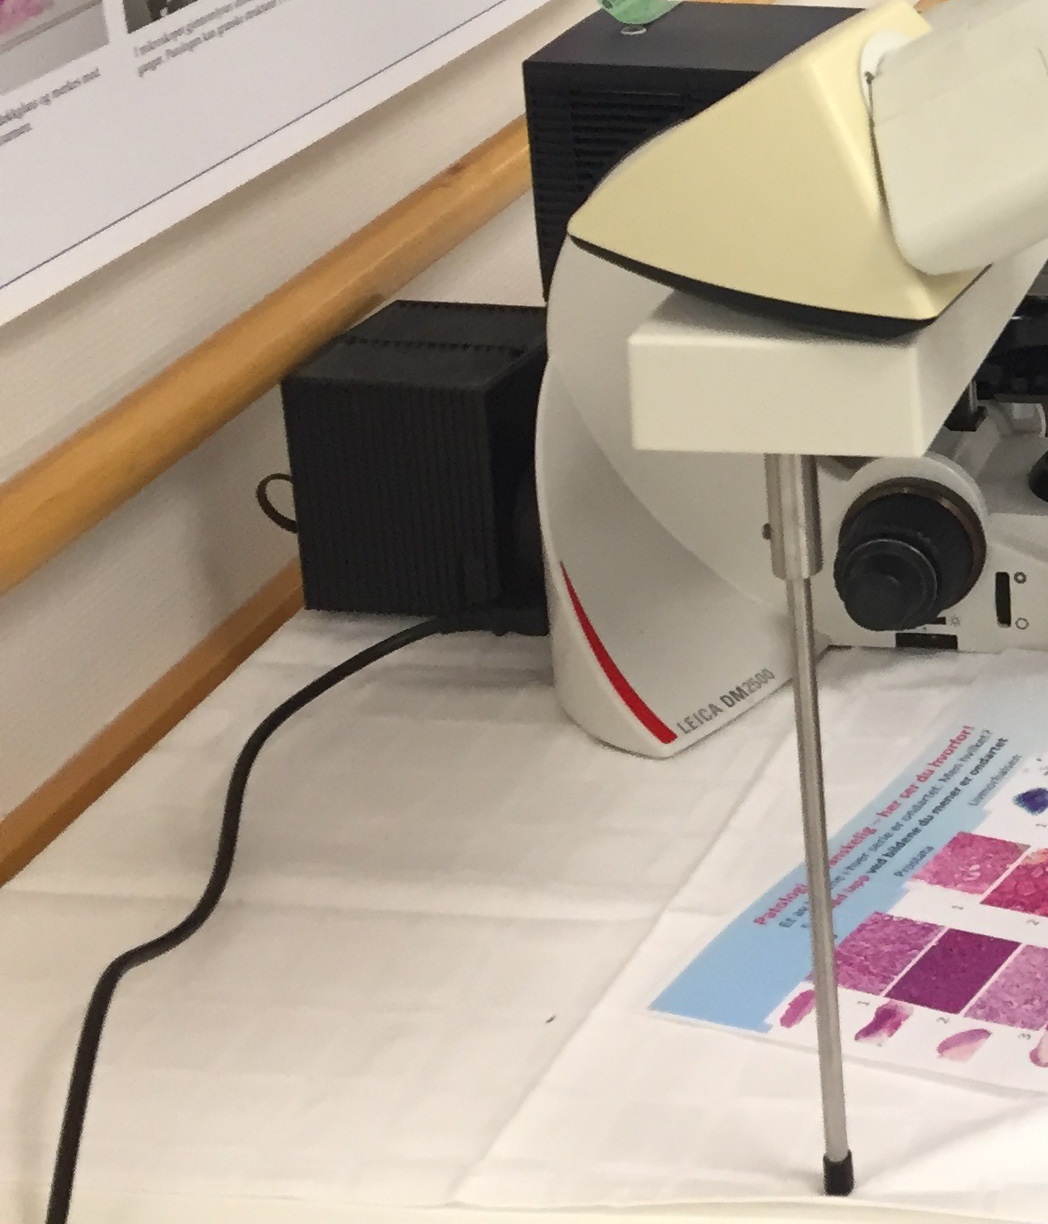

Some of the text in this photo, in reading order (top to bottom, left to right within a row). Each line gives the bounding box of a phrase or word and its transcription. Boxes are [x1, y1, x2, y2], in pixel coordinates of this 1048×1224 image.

[676, 668, 776, 735] LEICA DM2500
[828, 826, 878, 868] anskelig
[875, 800, 901, 817] her
[916, 769, 935, 783] du
[927, 725, 976, 767] hvorfor!
[917, 814, 935, 827] du
[931, 787, 962, 815] mener
[969, 737, 1009, 776] ondartet
